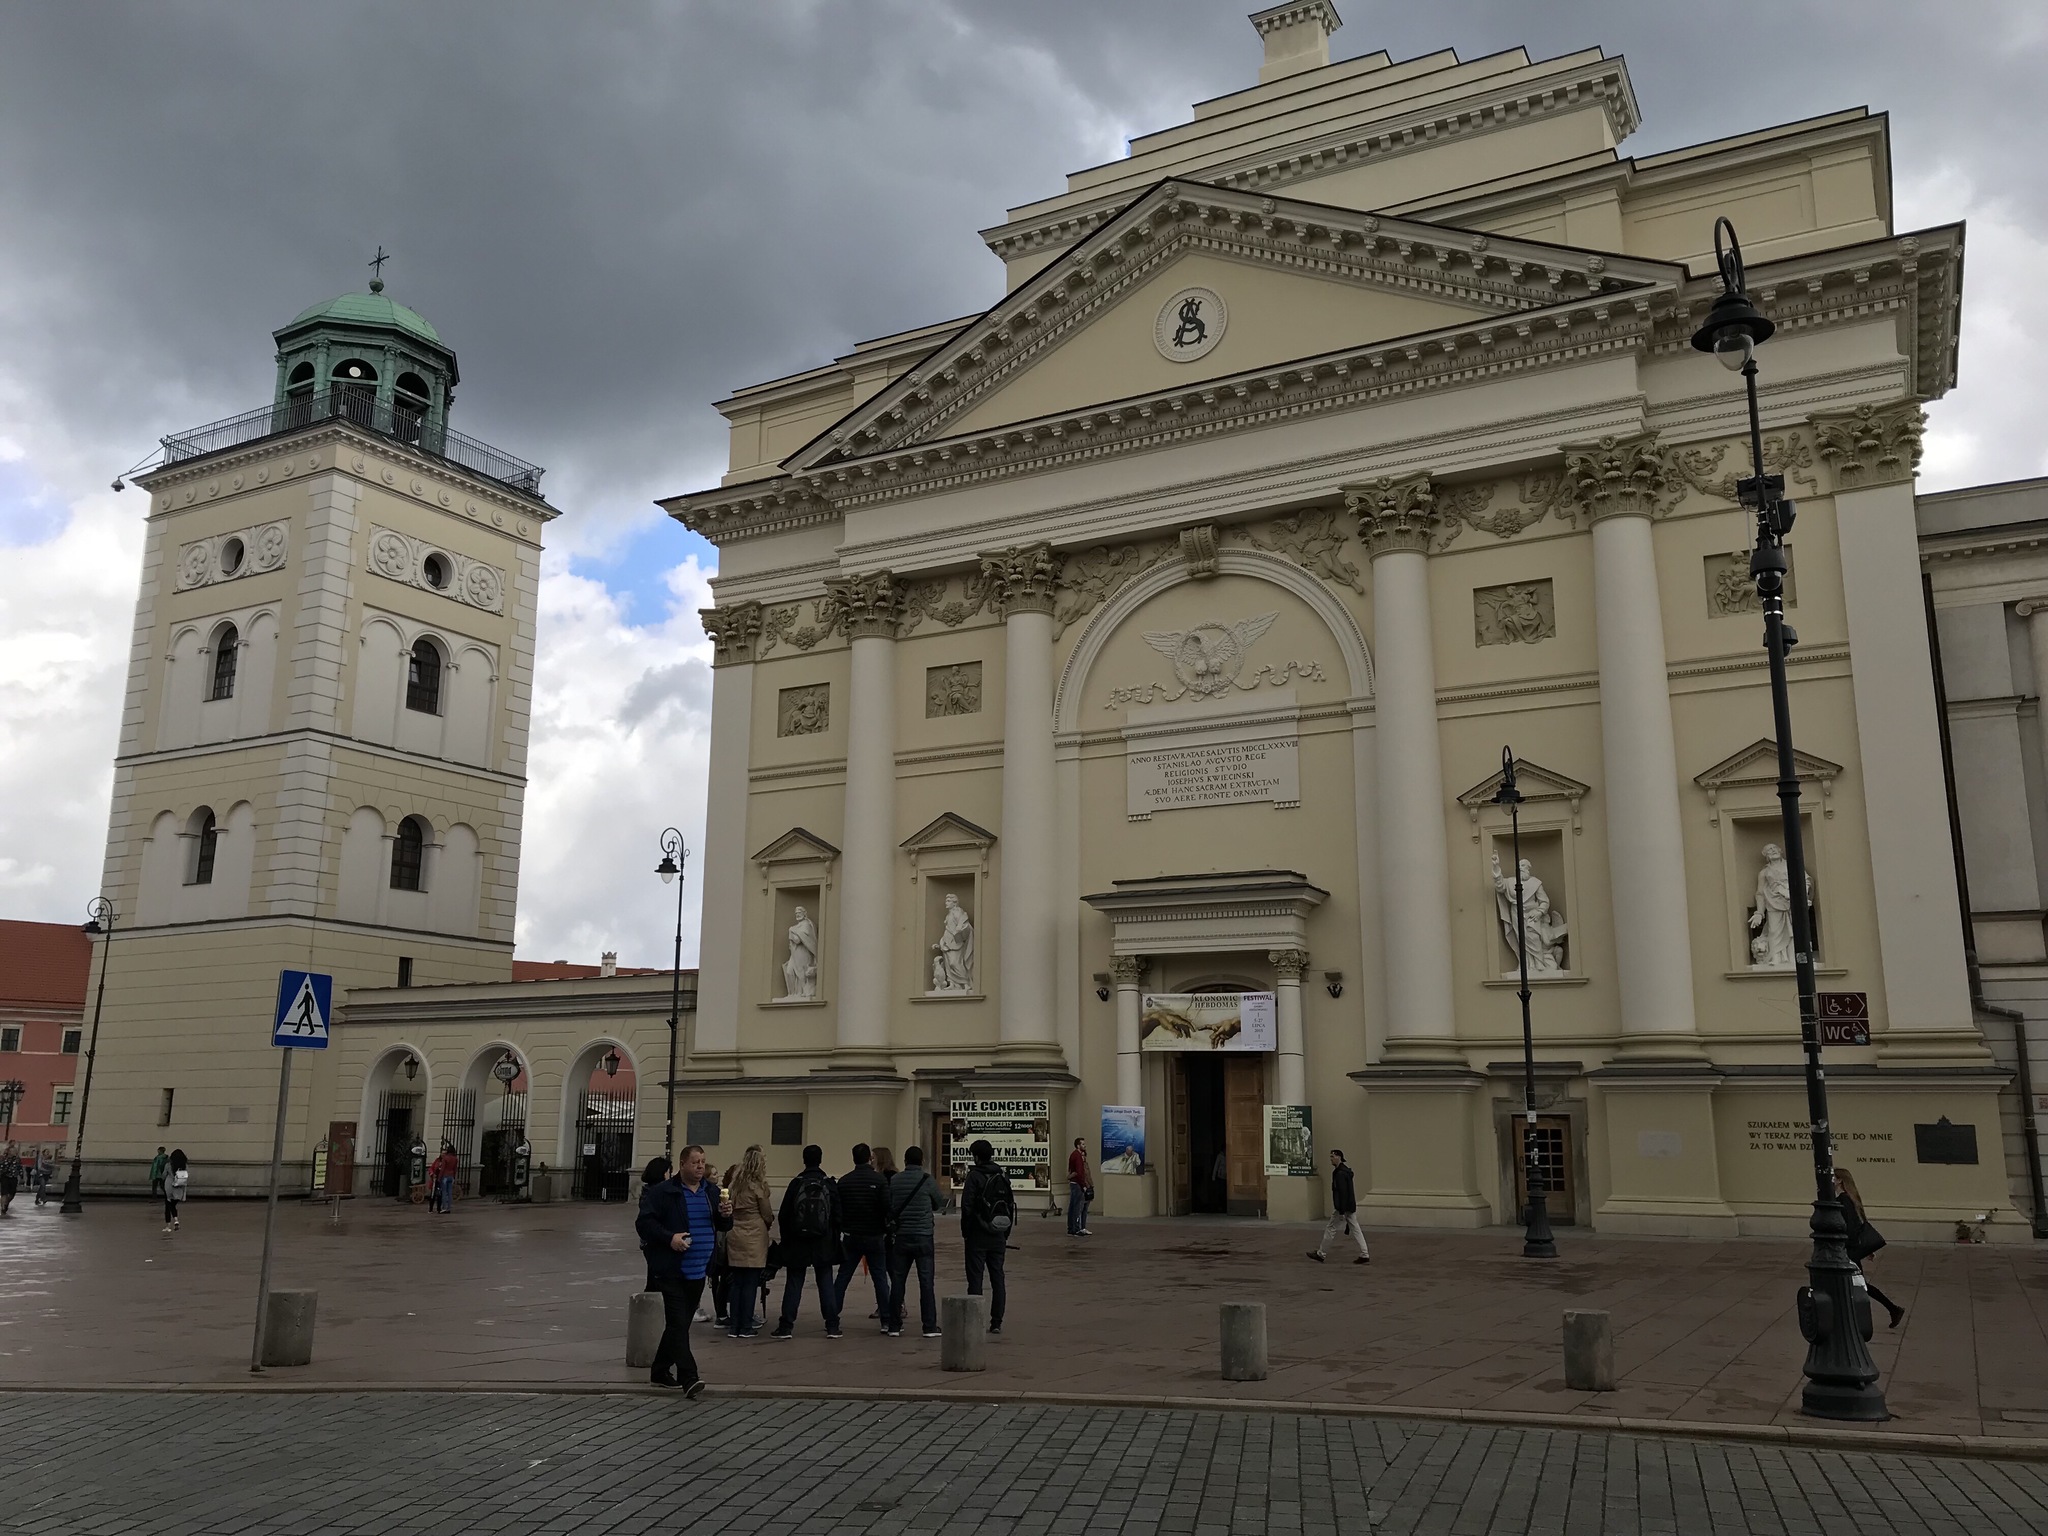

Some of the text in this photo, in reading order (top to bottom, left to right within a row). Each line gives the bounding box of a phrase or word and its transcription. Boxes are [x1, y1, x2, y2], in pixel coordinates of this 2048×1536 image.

[1130, 756, 1151, 764] ANNO
[1153, 750, 1205, 762] RESTAVRATAE
[1206, 747, 1240, 756] SALVTIS
[1157, 760, 1201, 770] STANISLAO
[1205, 756, 1242, 765] AVGVSTO
[1164, 763, 1247, 778] RELIGIONIS STVDIO
[1168, 772, 1254, 786] IOSEPHVS KWIECINSKI
[1172, 786, 1194, 794] HANC
[1196, 783, 1227, 792] SACRAM
[1230, 778, 1279, 789] EXTRVCTAM
[1155, 788, 1269, 804] SVO AERE FRONTE ORNAVIT
[1825, 1026, 1850, 1040] WC
[952, 1101, 1047, 1111] LIVE CONCERTS
[1005, 1148, 1017, 1156] NA
[1020, 1146, 1048, 1156] ŻYWO
